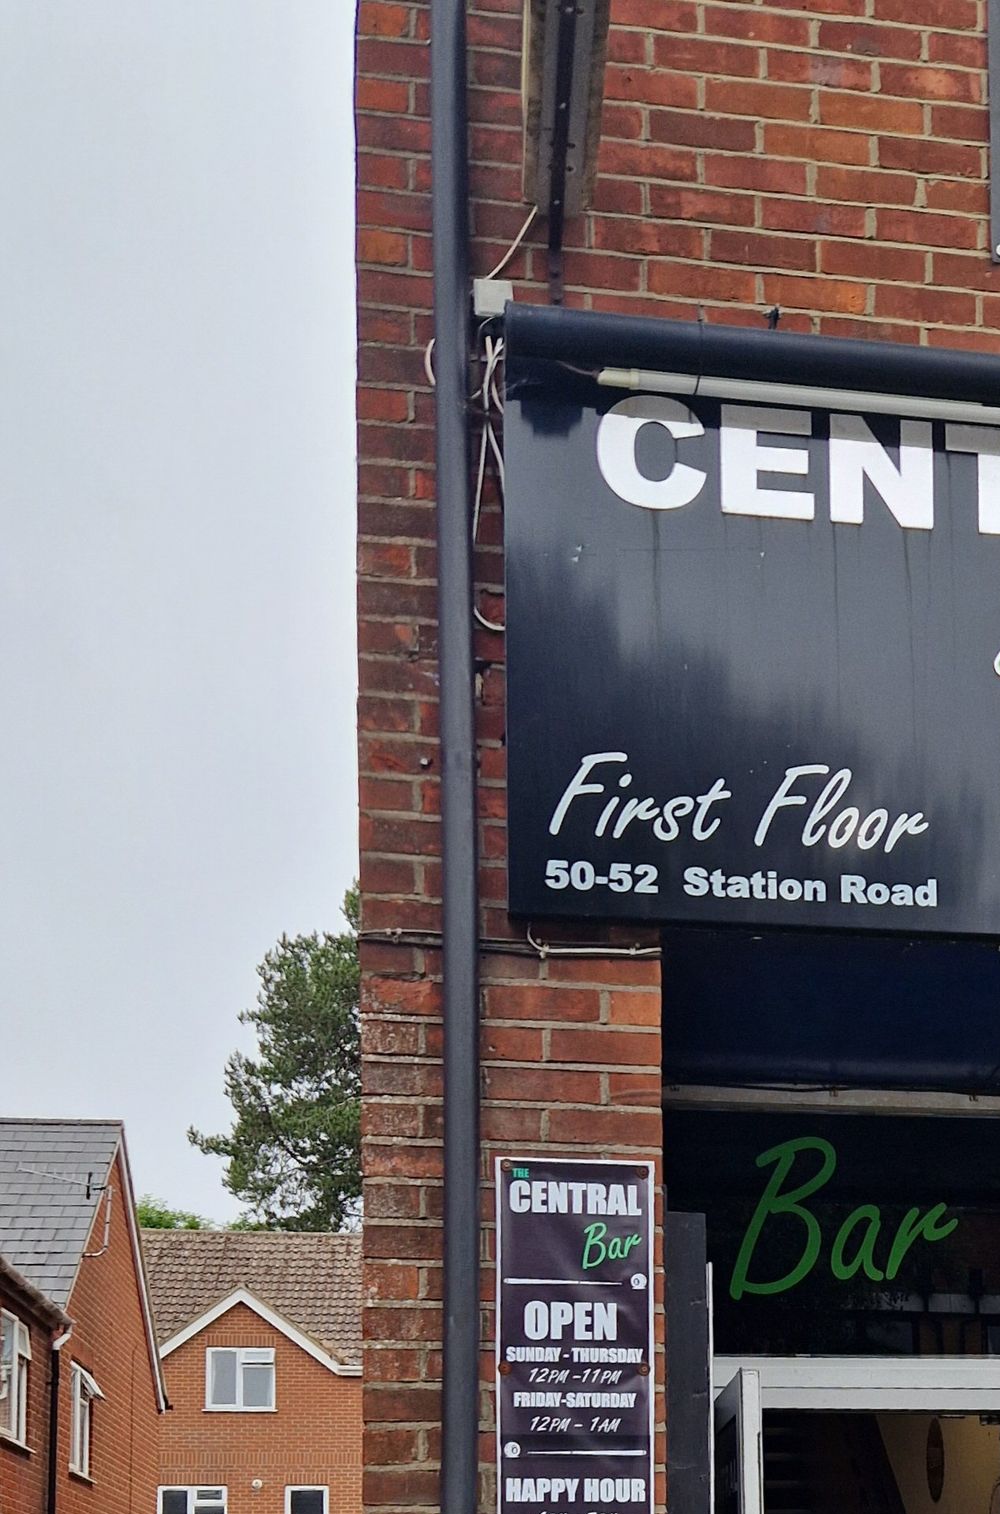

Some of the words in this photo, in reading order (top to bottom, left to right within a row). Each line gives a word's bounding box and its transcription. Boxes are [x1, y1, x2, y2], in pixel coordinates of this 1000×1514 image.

[548, 751, 732, 842] First
[753, 763, 930, 854] Floor
[544, 859, 660, 895] 50-52
[682, 866, 827, 903] Station
[839, 873, 938, 908] Road
[512, 1167, 529, 1178] THE
[509, 1180, 642, 1216] CENTRAL
[729, 1136, 959, 1301] Bar
[582, 1222, 642, 1270] Bar
[523, 1300, 617, 1341] OPEN
[506, 1346, 562, 1362] SUNDAY
[571, 1348, 643, 1363] THURSDAY
[528, 1368, 571, 1384] 12PM
[530, 1416, 571, 1432] 12PM
[590, 1417, 621, 1433] 1AM
[505, 1477, 579, 1503] HAPPY
[583, 1478, 646, 1503] HOUR
